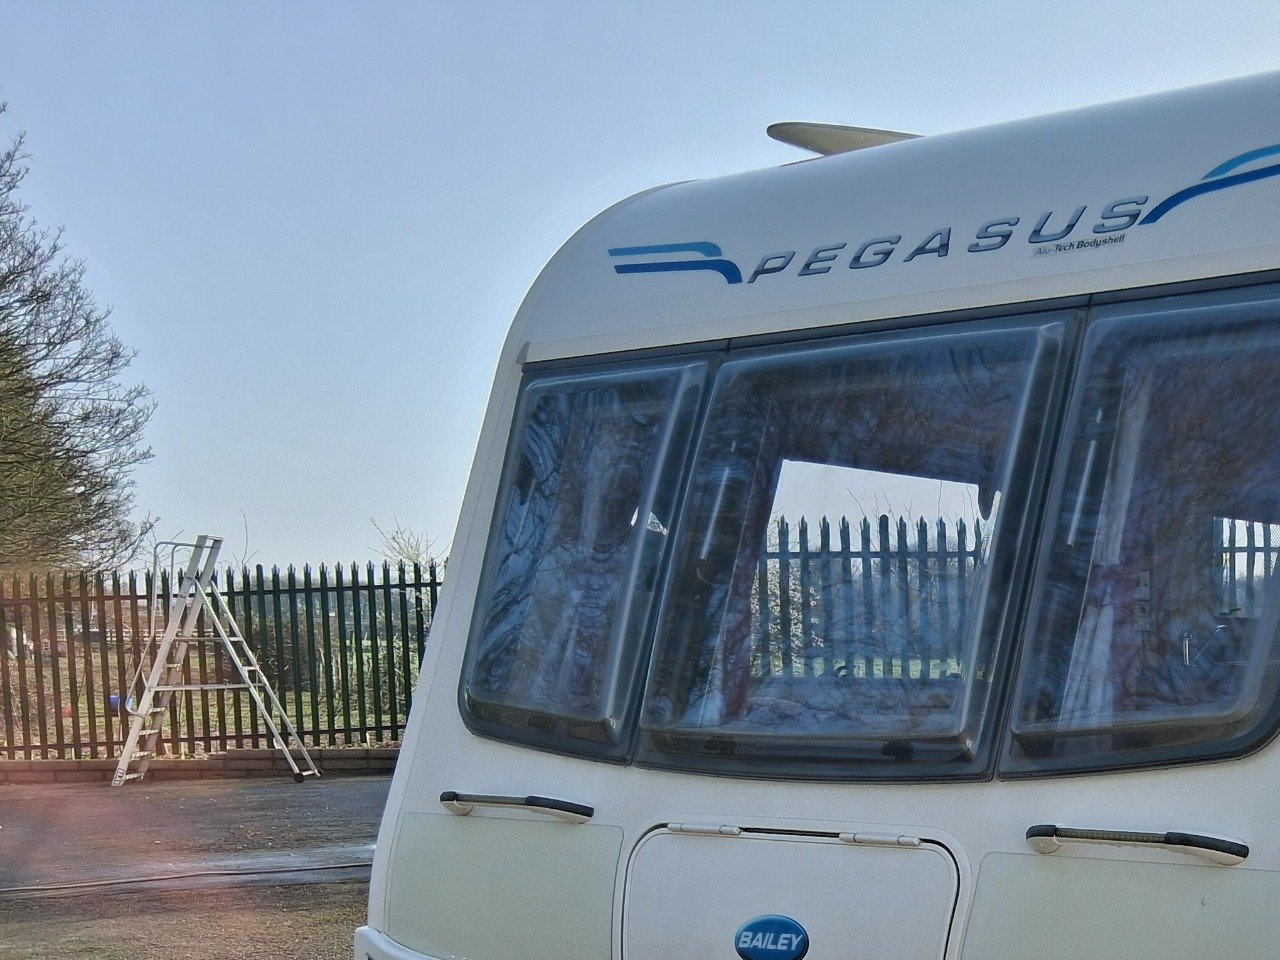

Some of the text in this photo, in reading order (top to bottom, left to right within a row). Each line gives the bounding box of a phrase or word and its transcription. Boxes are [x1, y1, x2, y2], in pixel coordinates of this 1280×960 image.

[747, 195, 1149, 284] PEGASUS
[1076, 234, 1125, 249] Bodyshell
[738, 931, 803, 951] BAILEY
